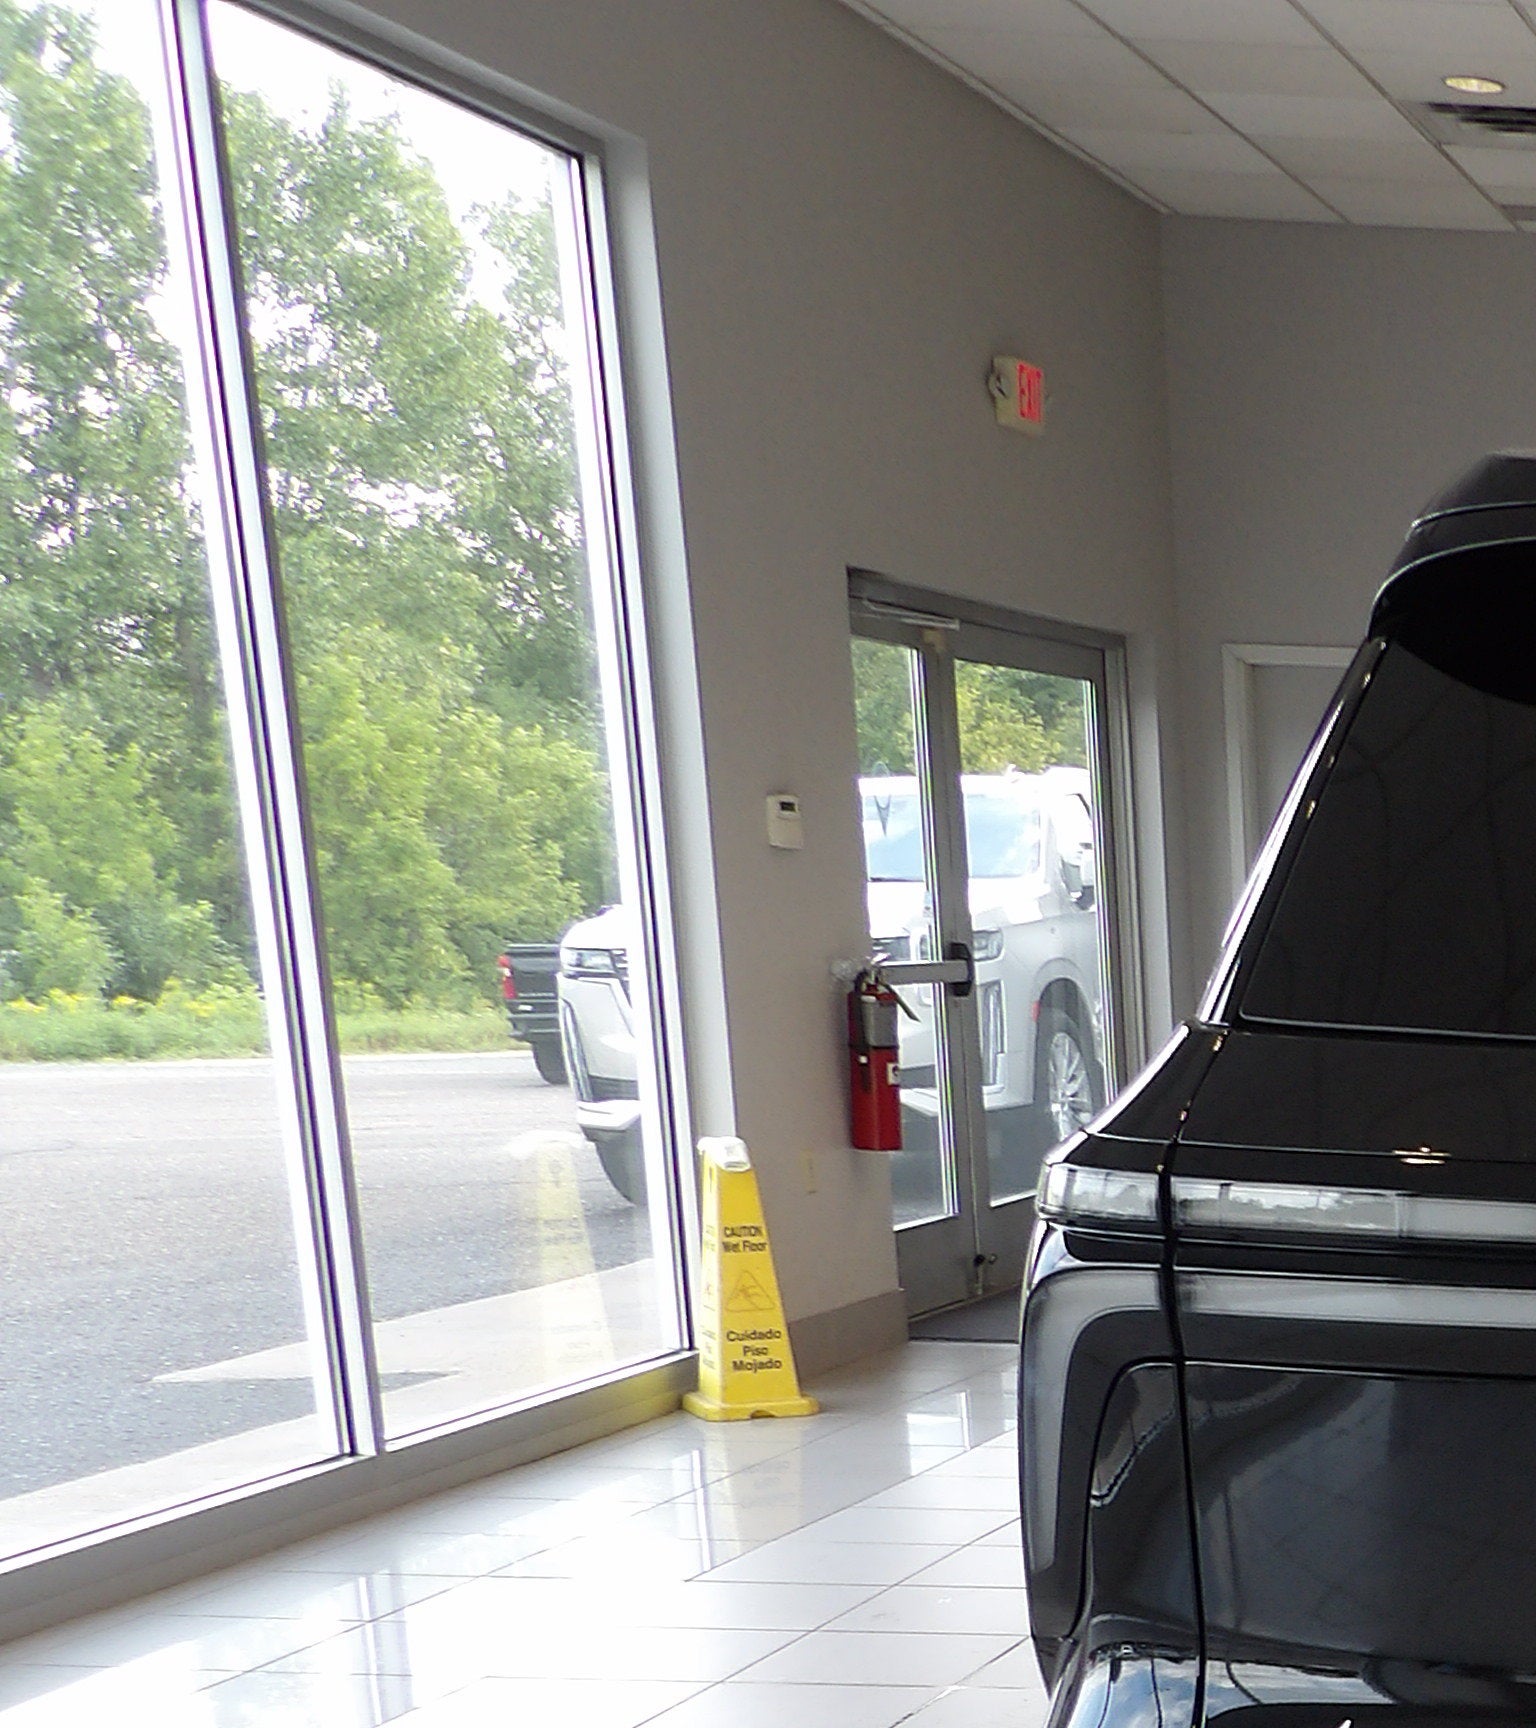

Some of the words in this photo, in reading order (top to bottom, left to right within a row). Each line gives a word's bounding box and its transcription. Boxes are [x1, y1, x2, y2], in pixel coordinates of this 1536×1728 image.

[743, 1240, 767, 1252] Floor
[726, 1328, 782, 1342] Cuidado
[742, 1345, 768, 1357] Piso
[732, 1359, 782, 1374] Mojado
